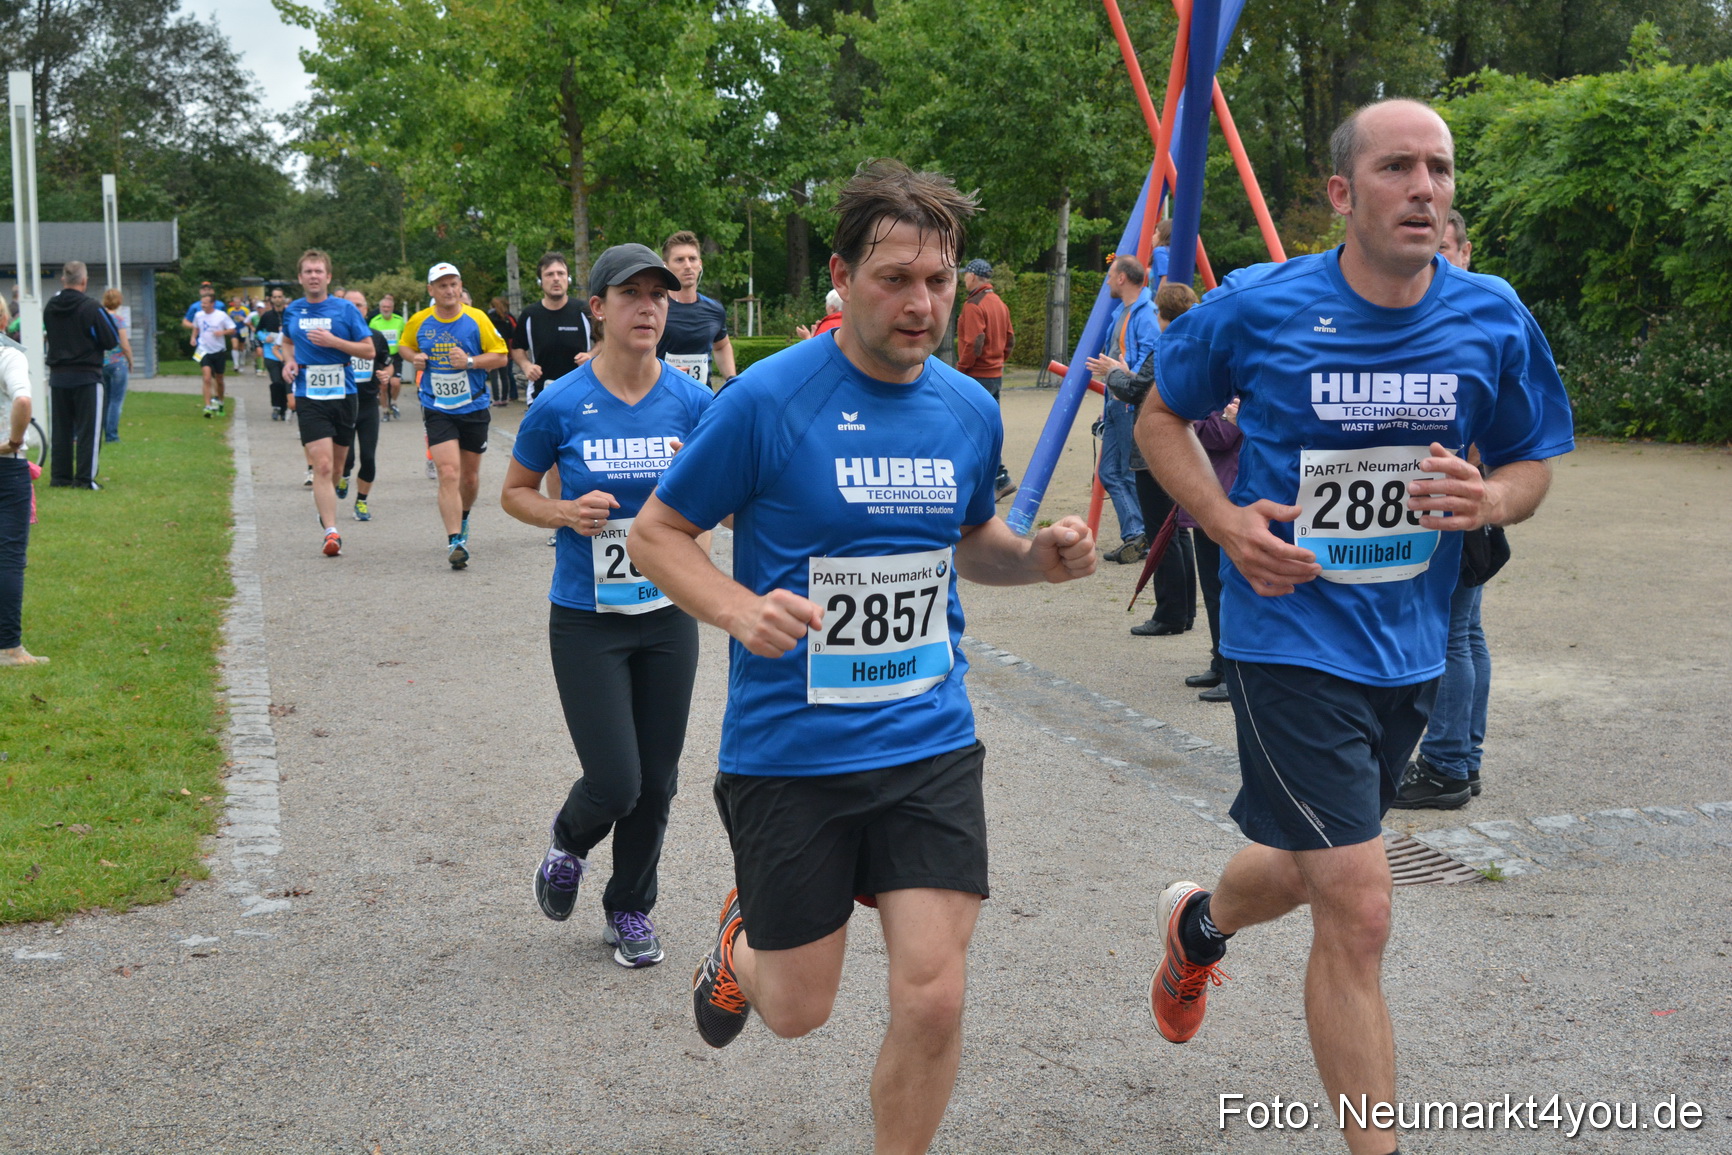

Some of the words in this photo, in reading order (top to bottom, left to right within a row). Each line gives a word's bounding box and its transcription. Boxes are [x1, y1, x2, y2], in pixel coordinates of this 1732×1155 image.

[1314, 325, 1336, 333] erima
[310, 373, 340, 387] 2911
[435, 380, 467, 396] 3382
[1311, 372, 1459, 404] HUBER
[1342, 406, 1451, 418] TECHNOLOGY
[837, 423, 866, 431] erima
[1341, 423, 1374, 432] WASTE
[1377, 421, 1409, 431] WATER
[1411, 422, 1448, 431] Solutions
[583, 436, 680, 460] HUBER
[607, 472, 631, 480] WASTE
[632, 471, 657, 479] WATER
[835, 457, 958, 487] HUBER
[1304, 463, 1354, 478] PARTL
[1357, 459, 1421, 473] Neumark
[866, 490, 953, 500] TECHNOLOGY
[867, 506, 894, 514] WASTE
[896, 506, 924, 514] WATER
[925, 506, 954, 515] Solutions
[1327, 540, 1412, 565] Willibald
[813, 572, 867, 586] PARTL
[871, 567, 932, 585] Neumarkt
[638, 586, 658, 600] Eva
[826, 585, 939, 647] 2857
[852, 655, 917, 682] Herbert
